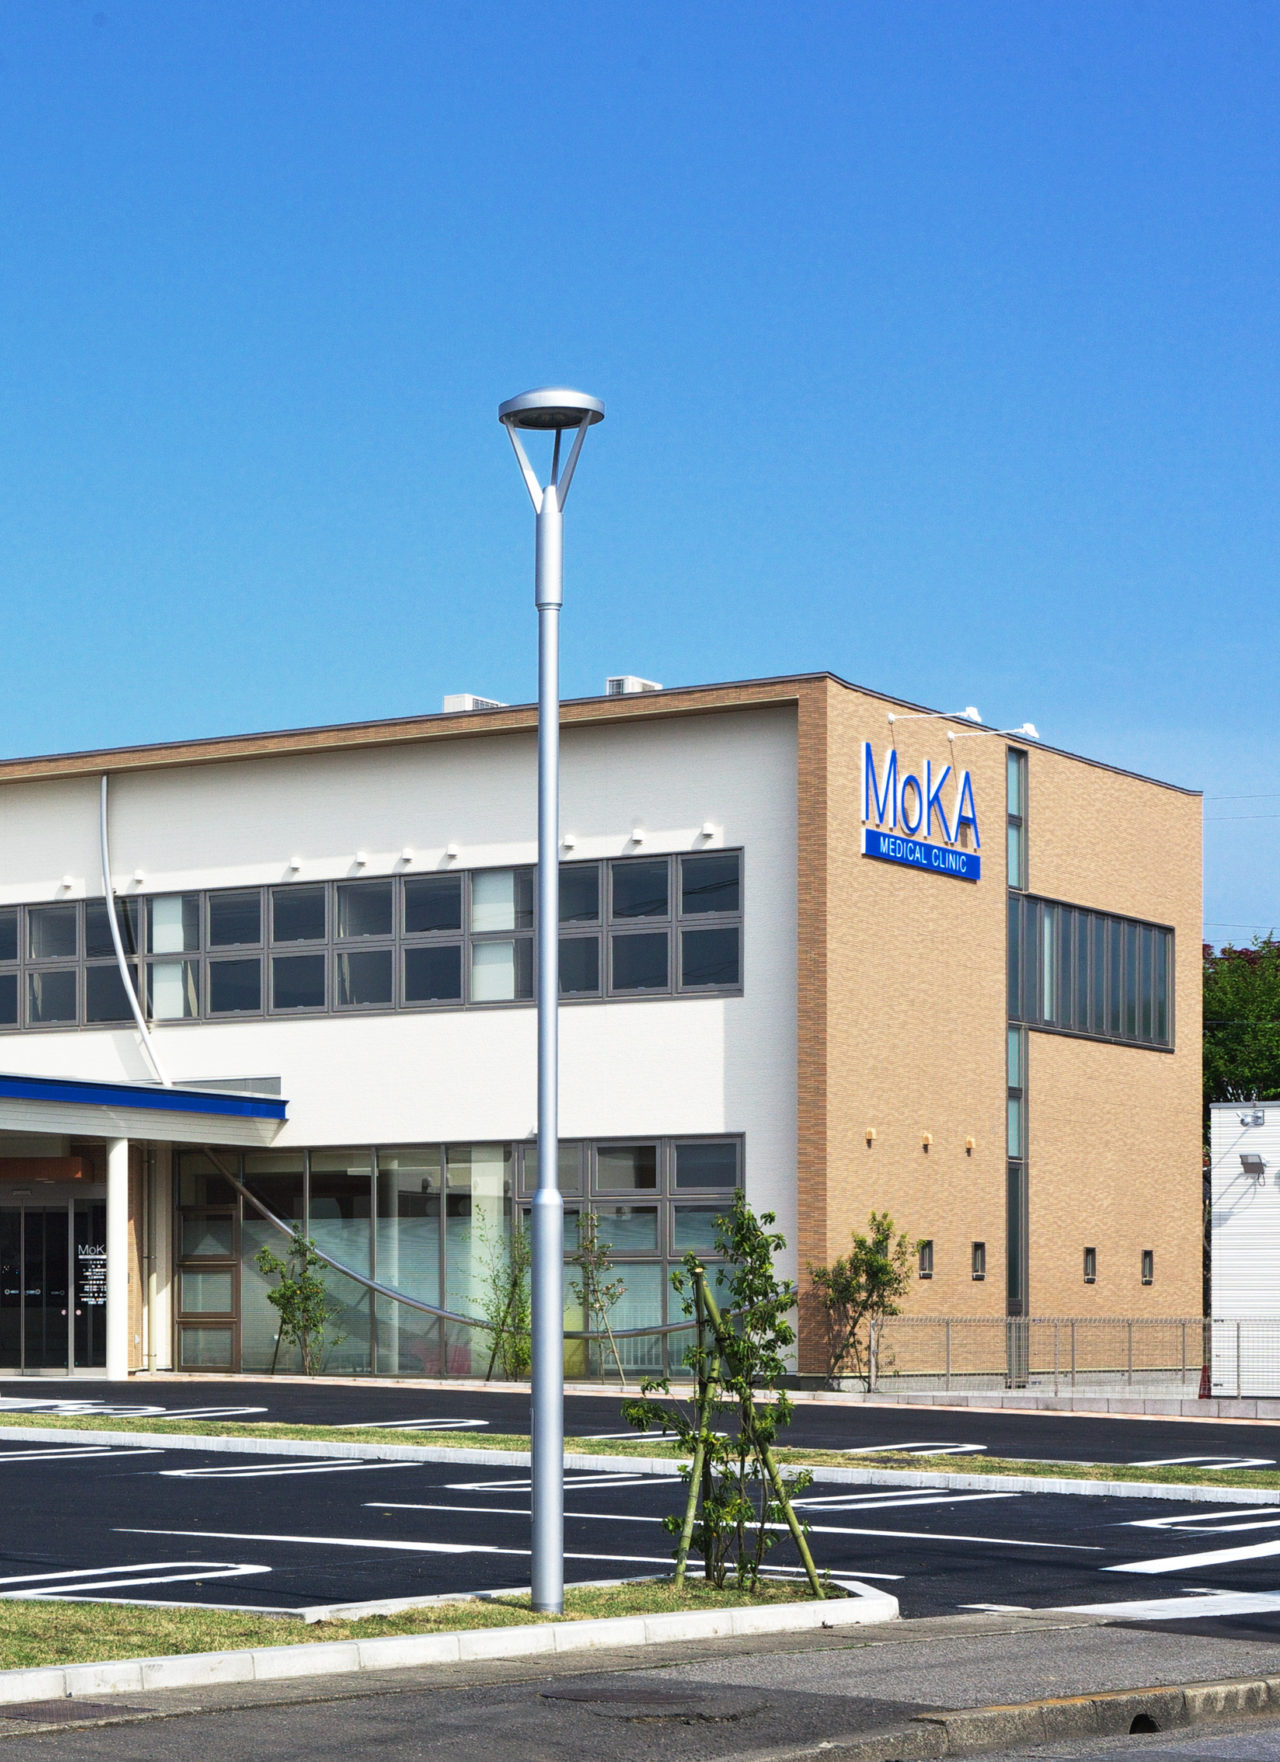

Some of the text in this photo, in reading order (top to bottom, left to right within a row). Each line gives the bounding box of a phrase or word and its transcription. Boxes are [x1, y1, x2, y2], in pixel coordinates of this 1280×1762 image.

[861, 741, 980, 850] MoKA
[879, 836, 967, 873] MEDICAL CLINIC
[78, 1244, 106, 1255] MoK
